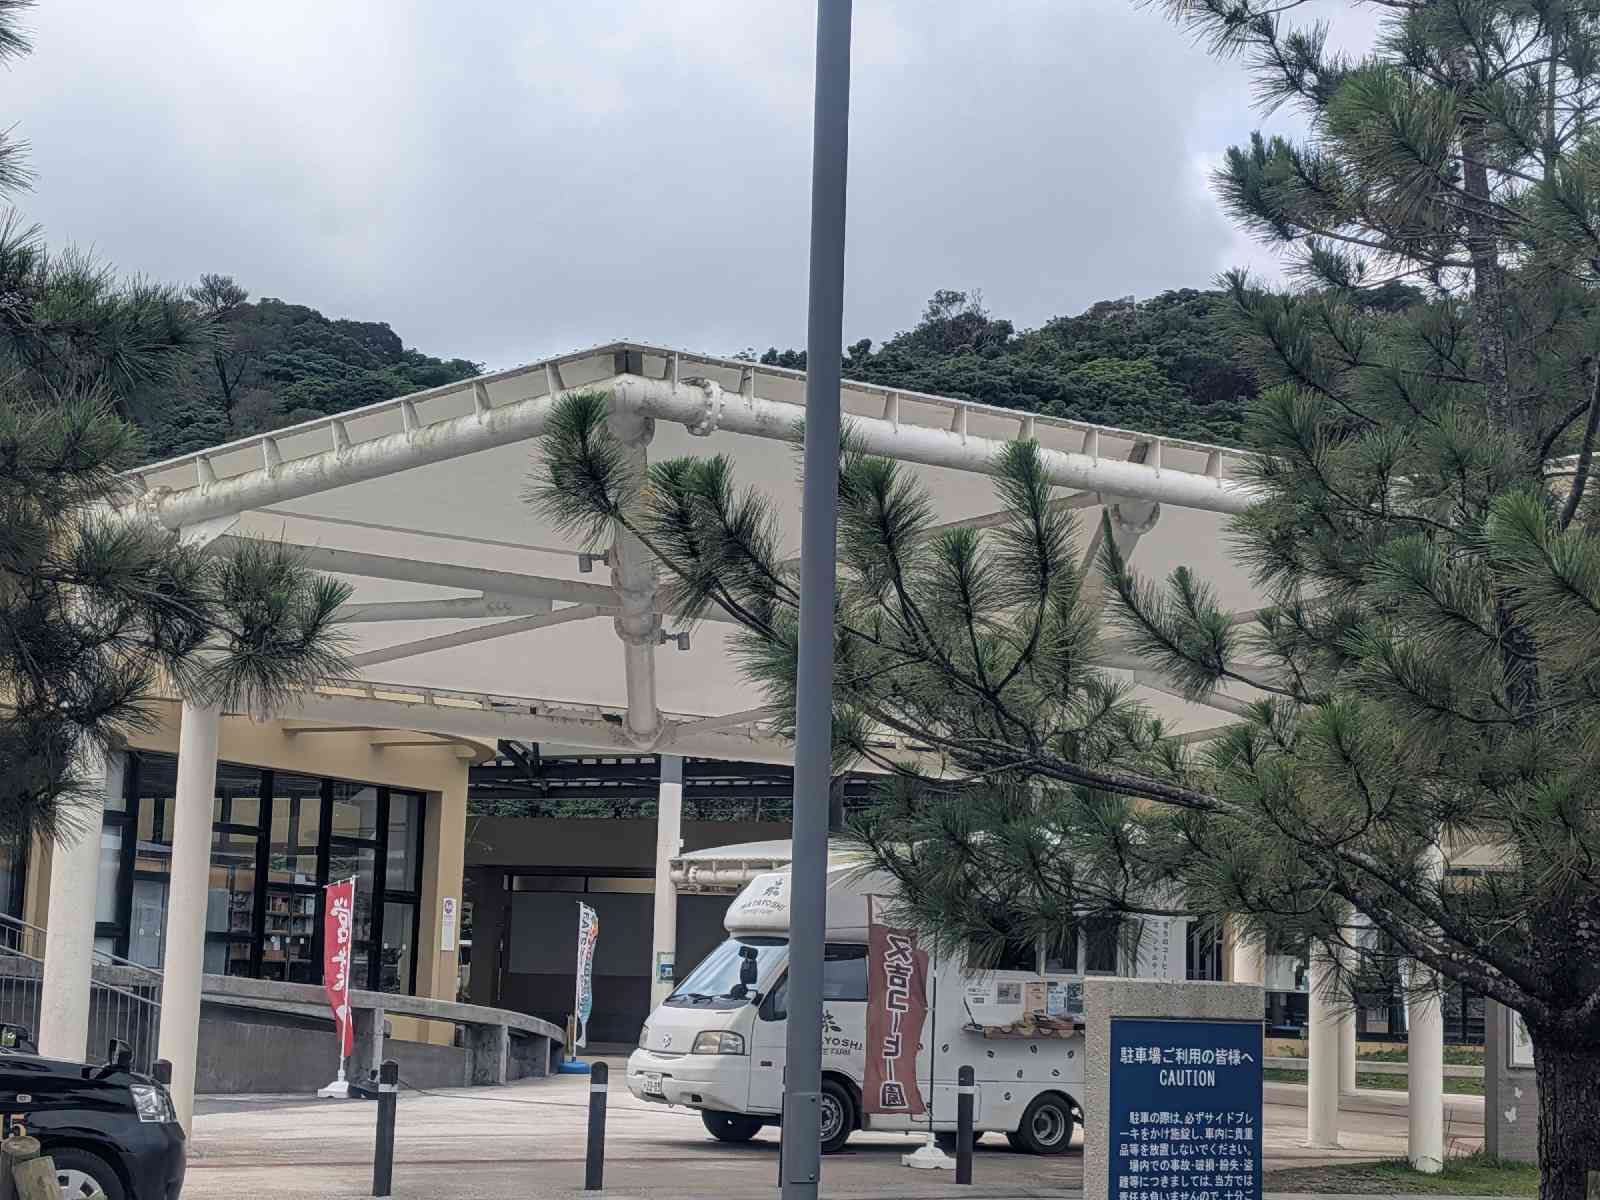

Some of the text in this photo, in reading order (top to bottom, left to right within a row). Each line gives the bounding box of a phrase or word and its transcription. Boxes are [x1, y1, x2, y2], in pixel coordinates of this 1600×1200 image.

[1120, 1046, 1254, 1066] 駐車場ご利用の皆様へ
[1159, 1069, 1216, 1087] CAUTION
